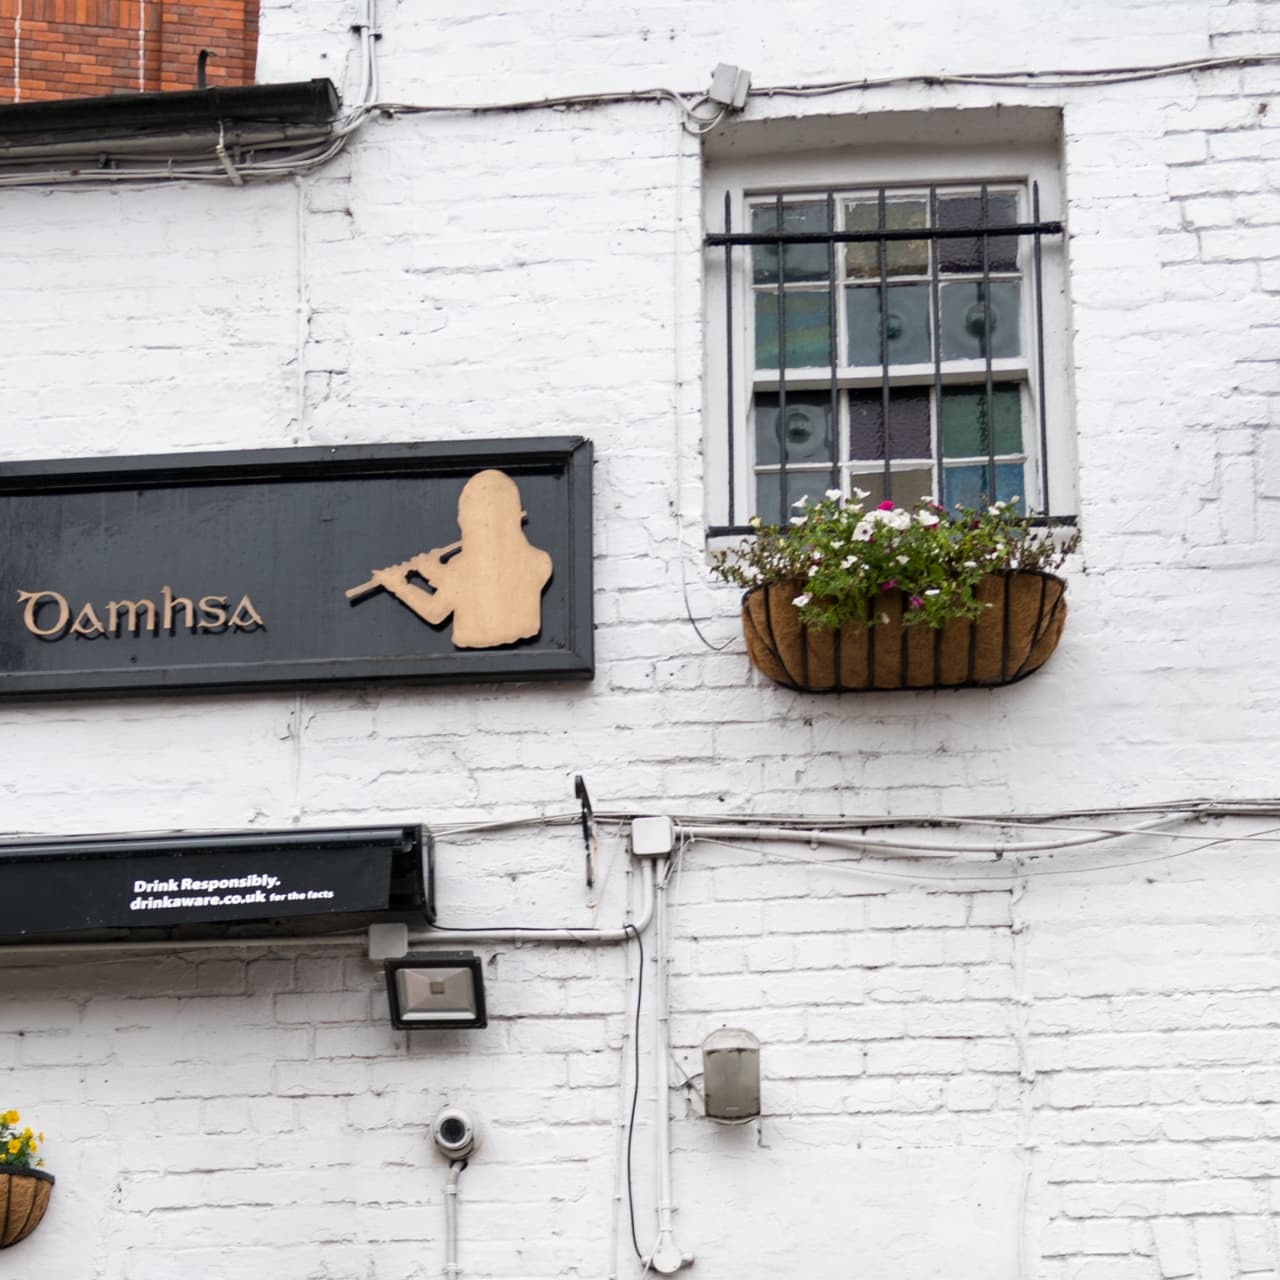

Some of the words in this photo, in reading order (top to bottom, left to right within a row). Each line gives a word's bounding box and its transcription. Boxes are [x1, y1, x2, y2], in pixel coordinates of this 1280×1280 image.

[16, 585, 264, 638] Damhsa
[133, 878, 179, 893] Drink
[181, 874, 281, 892] Responsibly.
[130, 891, 266, 910] drinkaware.co.uk
[269, 893, 287, 902] for
[288, 892, 306, 900] the
[307, 889, 334, 899] facts
